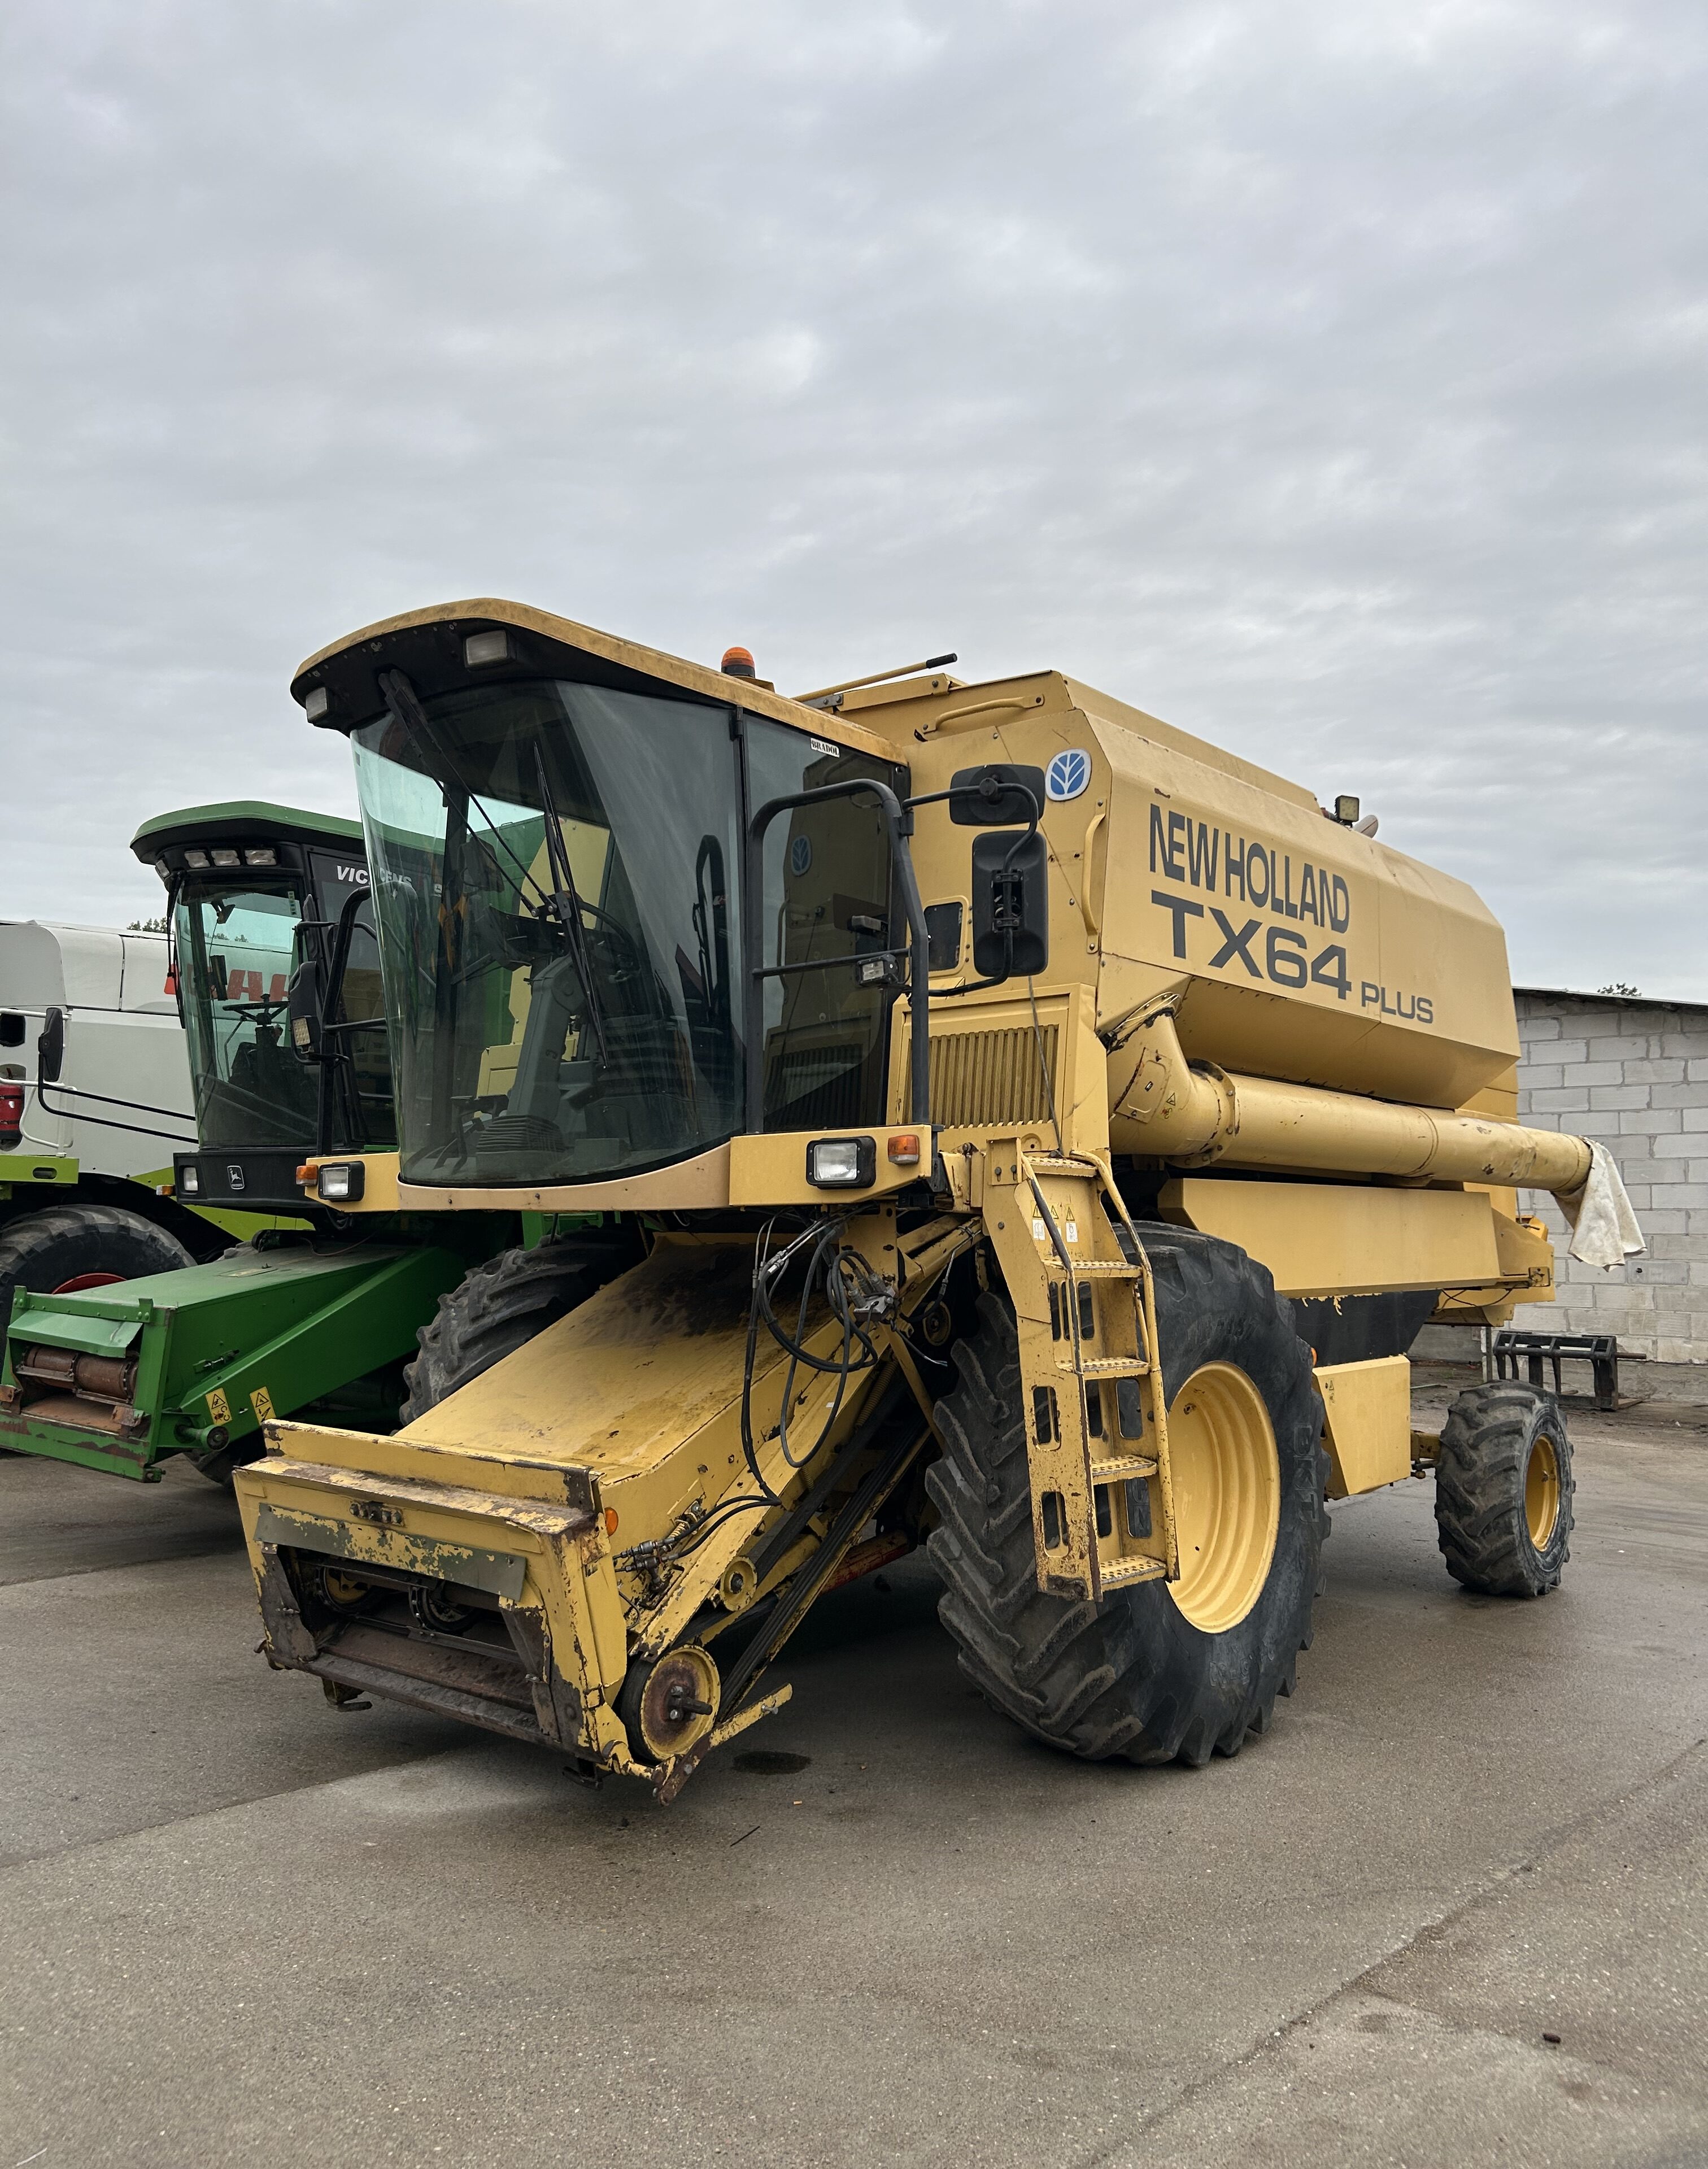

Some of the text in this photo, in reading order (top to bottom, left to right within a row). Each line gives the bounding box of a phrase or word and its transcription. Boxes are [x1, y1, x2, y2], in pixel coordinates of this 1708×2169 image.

[812, 741, 839, 756] BRADOL
[1150, 803, 1349, 934] NEW HOLLAND
[1151, 889, 1433, 1023] TX64 PLUS
